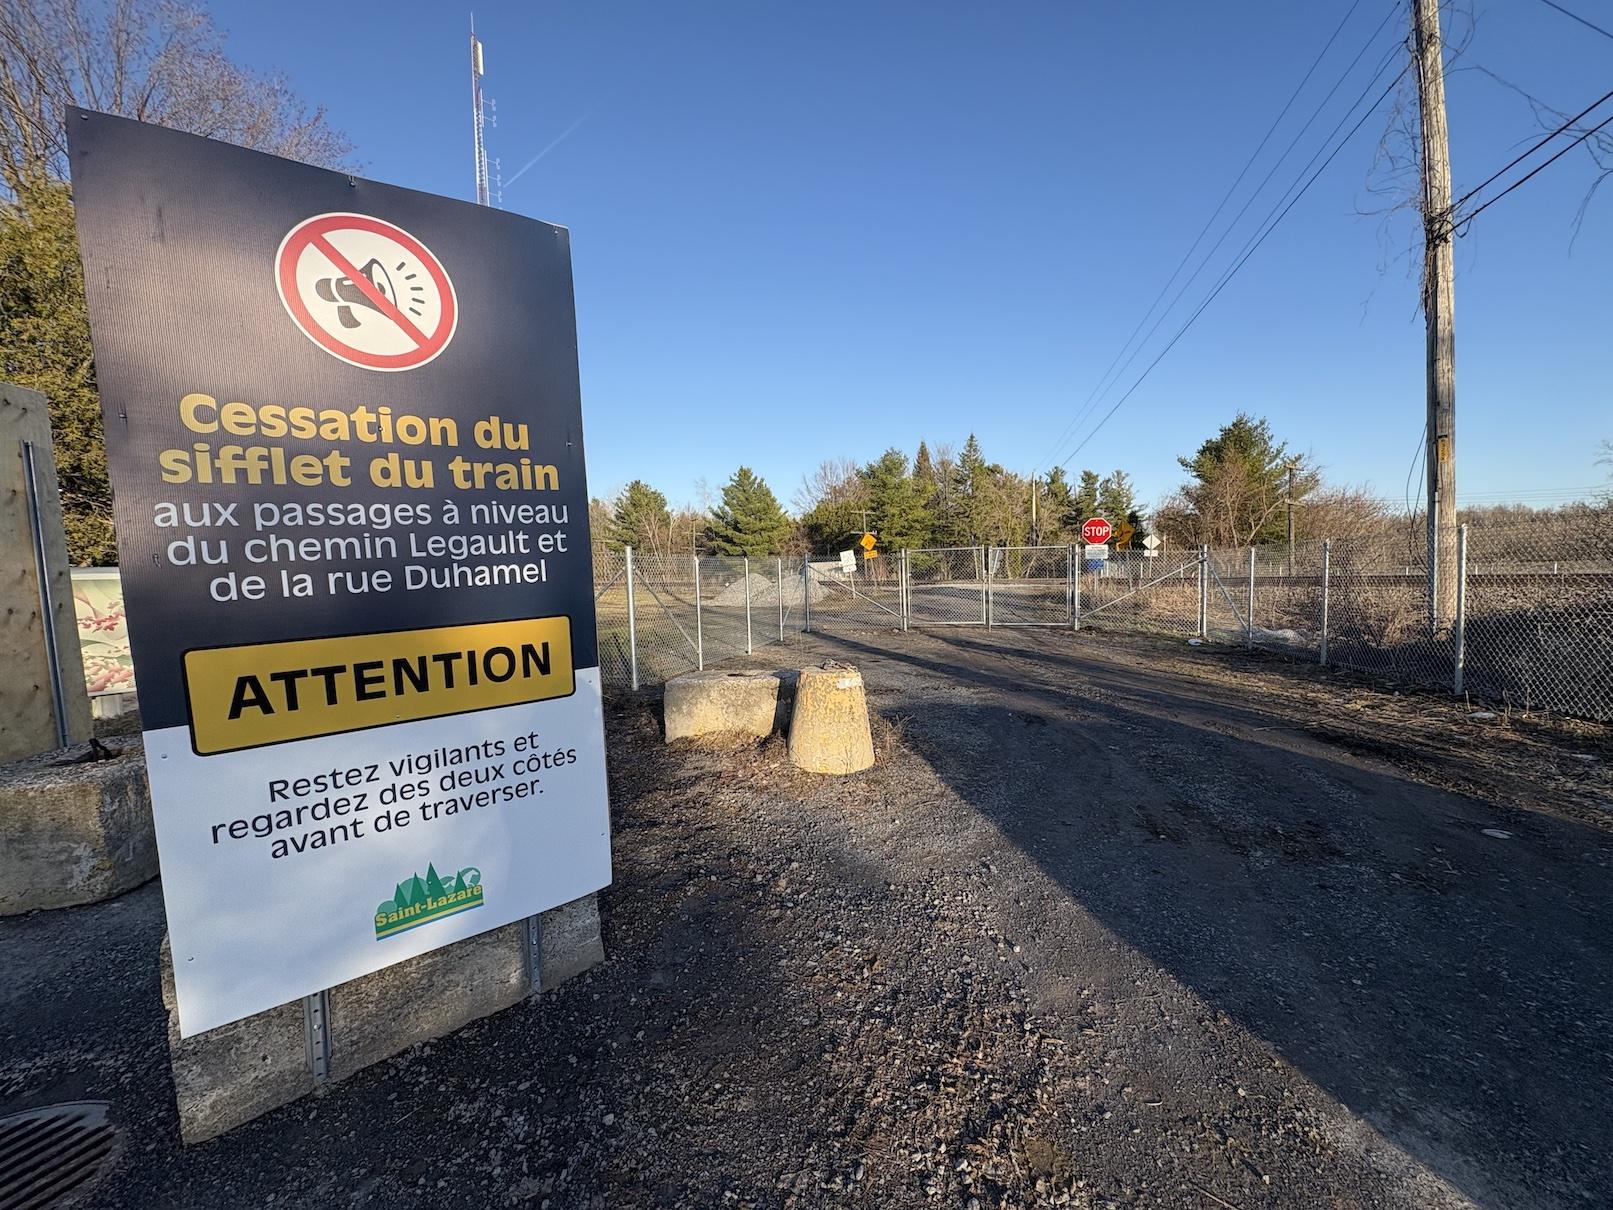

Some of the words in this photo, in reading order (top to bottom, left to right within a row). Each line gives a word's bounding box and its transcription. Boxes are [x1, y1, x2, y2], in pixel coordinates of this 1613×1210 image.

[179, 393, 459, 447] Cessation
[473, 416, 530, 450] du
[158, 443, 352, 488] sifflet
[369, 454, 434, 490] du
[448, 455, 560, 491] train
[153, 501, 239, 528] aux
[254, 500, 431, 531] passages
[442, 499, 461, 526] à
[470, 501, 569, 525] niveau
[1084, 526, 1110, 537] STOP
[166, 534, 227, 567] du
[243, 533, 398, 563] chemin
[409, 528, 530, 560] Legault
[537, 529, 567, 554] et
[208, 570, 265, 602] de
[281, 568, 313, 597] la
[328, 568, 392, 595] rue
[404, 559, 547, 590] Duhamel
[227, 641, 552, 720] ATTENTION
[268, 763, 379, 803] Restez
[389, 736, 506, 777] vigilants
[513, 731, 539, 751] et
[211, 790, 368, 845] regardez
[379, 777, 430, 806] des
[439, 764, 504, 790] deux
[512, 747, 578, 776] côtés
[271, 817, 365, 859] avant
[373, 808, 411, 833] de
[419, 777, 544, 822] traverser.
[375, 884, 482, 927] Saint-Lazare
